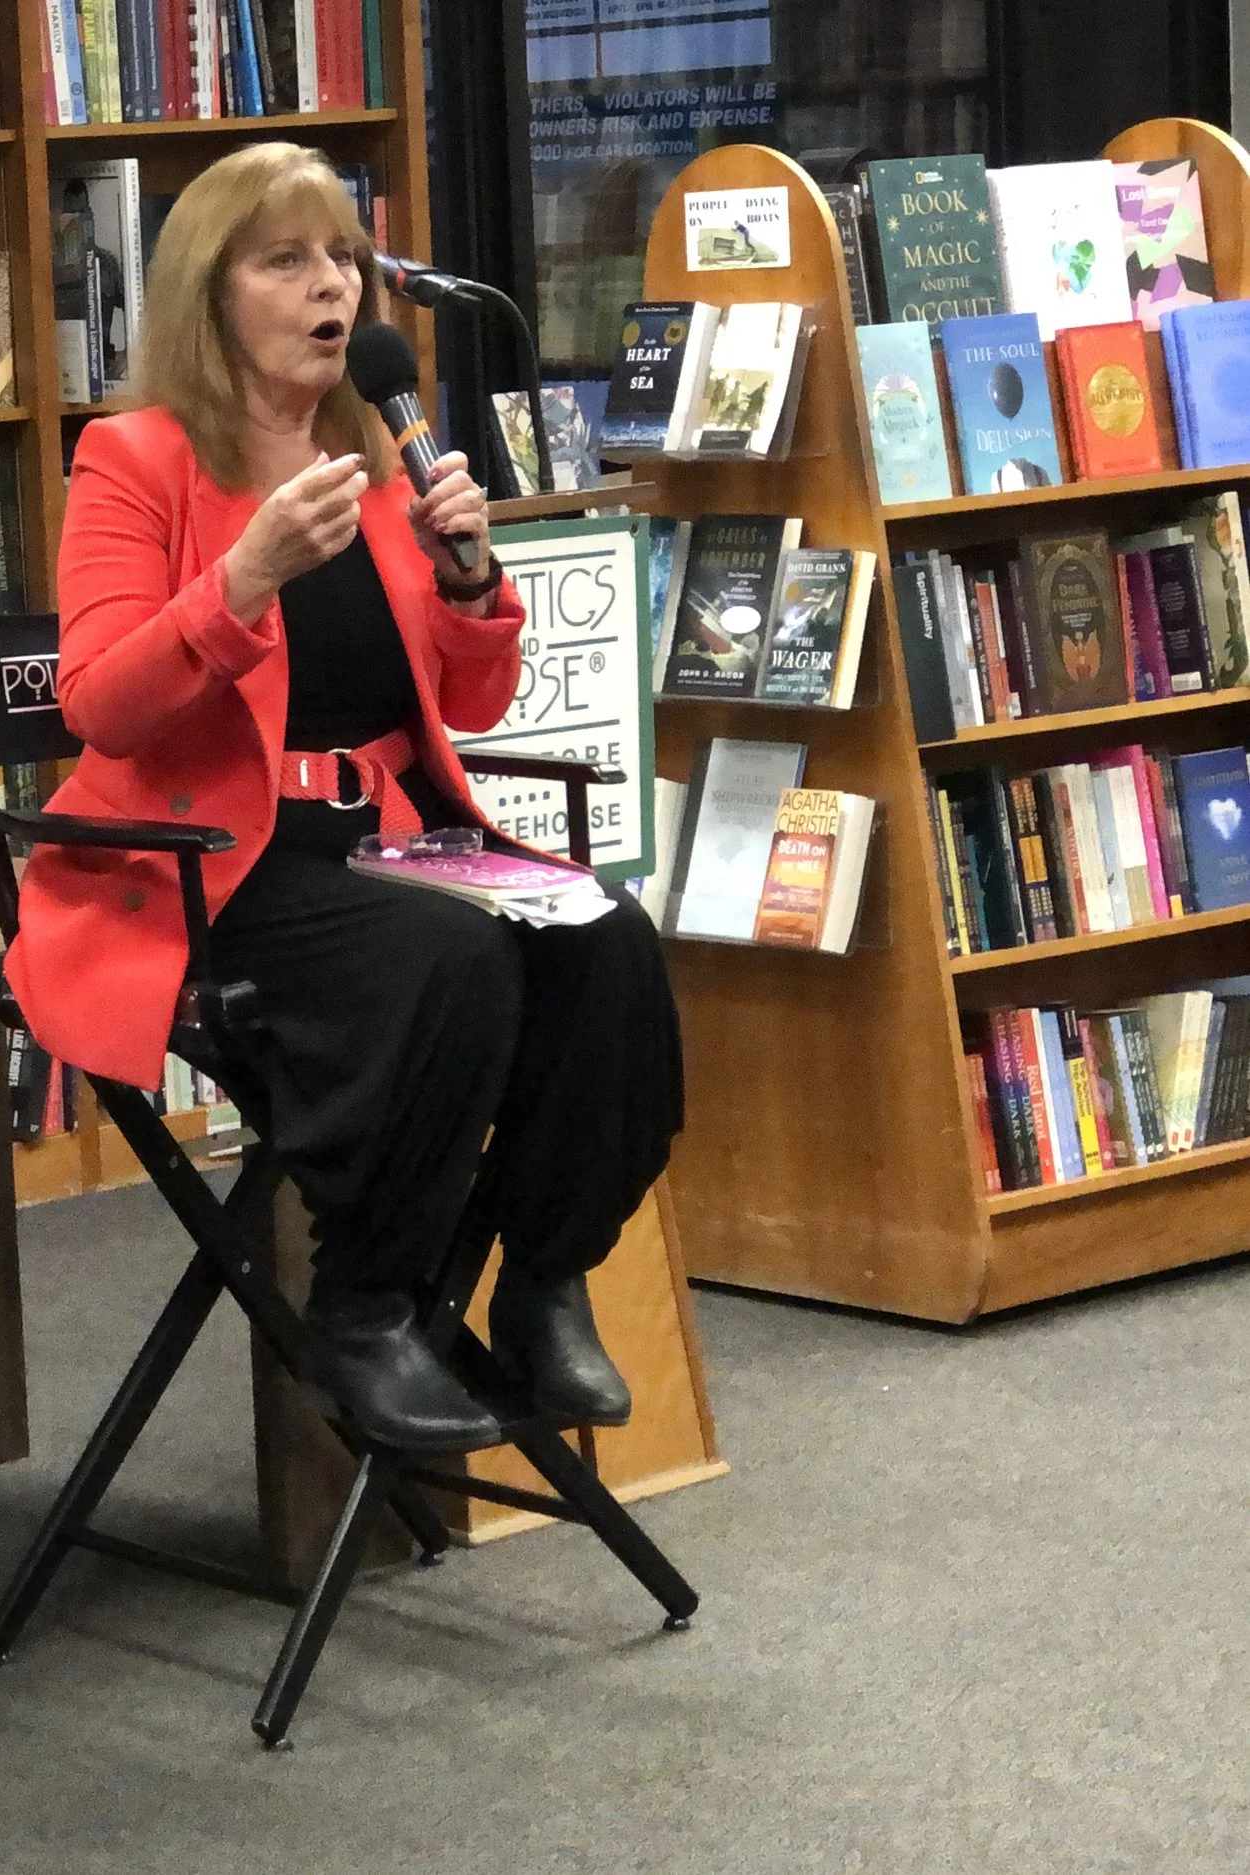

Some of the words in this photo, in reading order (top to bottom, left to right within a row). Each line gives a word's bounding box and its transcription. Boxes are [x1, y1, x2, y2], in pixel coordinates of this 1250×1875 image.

[51, 5, 62, 54] MARILYN
[84, 13, 95, 53] PLANET
[604, 87, 700, 109] VIOLATORS
[705, 84, 747, 103] WILL
[753, 81, 777, 100] BE
[529, 117, 597, 137] OWNERS
[602, 114, 643, 133] RISK
[648, 112, 684, 130] AND
[901, 188, 968, 216] BOOK
[929, 221, 945, 233] OF
[86, 249, 94, 269] The
[903, 240, 981, 269] MAGIC
[920, 279, 946, 292] AND
[950, 275, 971, 289] THE
[902, 297, 996, 325] OCCULT
[626, 348, 671, 361] HEART
[963, 346, 995, 364] THE
[999, 342, 1040, 359] SOUL
[630, 377, 654, 389] SEA
[975, 427, 1052, 454] DELUSION
[787, 563, 813, 574] DAVID
[815, 563, 847, 574] GRANN
[912, 571, 937, 640] Spirituality
[795, 637, 815, 647] THE
[772, 651, 832, 670] WAGER
[782, 791, 839, 813] AGATHA
[777, 813, 838, 834] CHRISTIE
[778, 839, 810, 856] DEATH
[993, 1012, 1014, 1084] CHASING
[1007, 1097, 1023, 1139] DARK
[1025, 1063, 1041, 1096] Red
[1019, 1094, 1037, 1136] DARK
